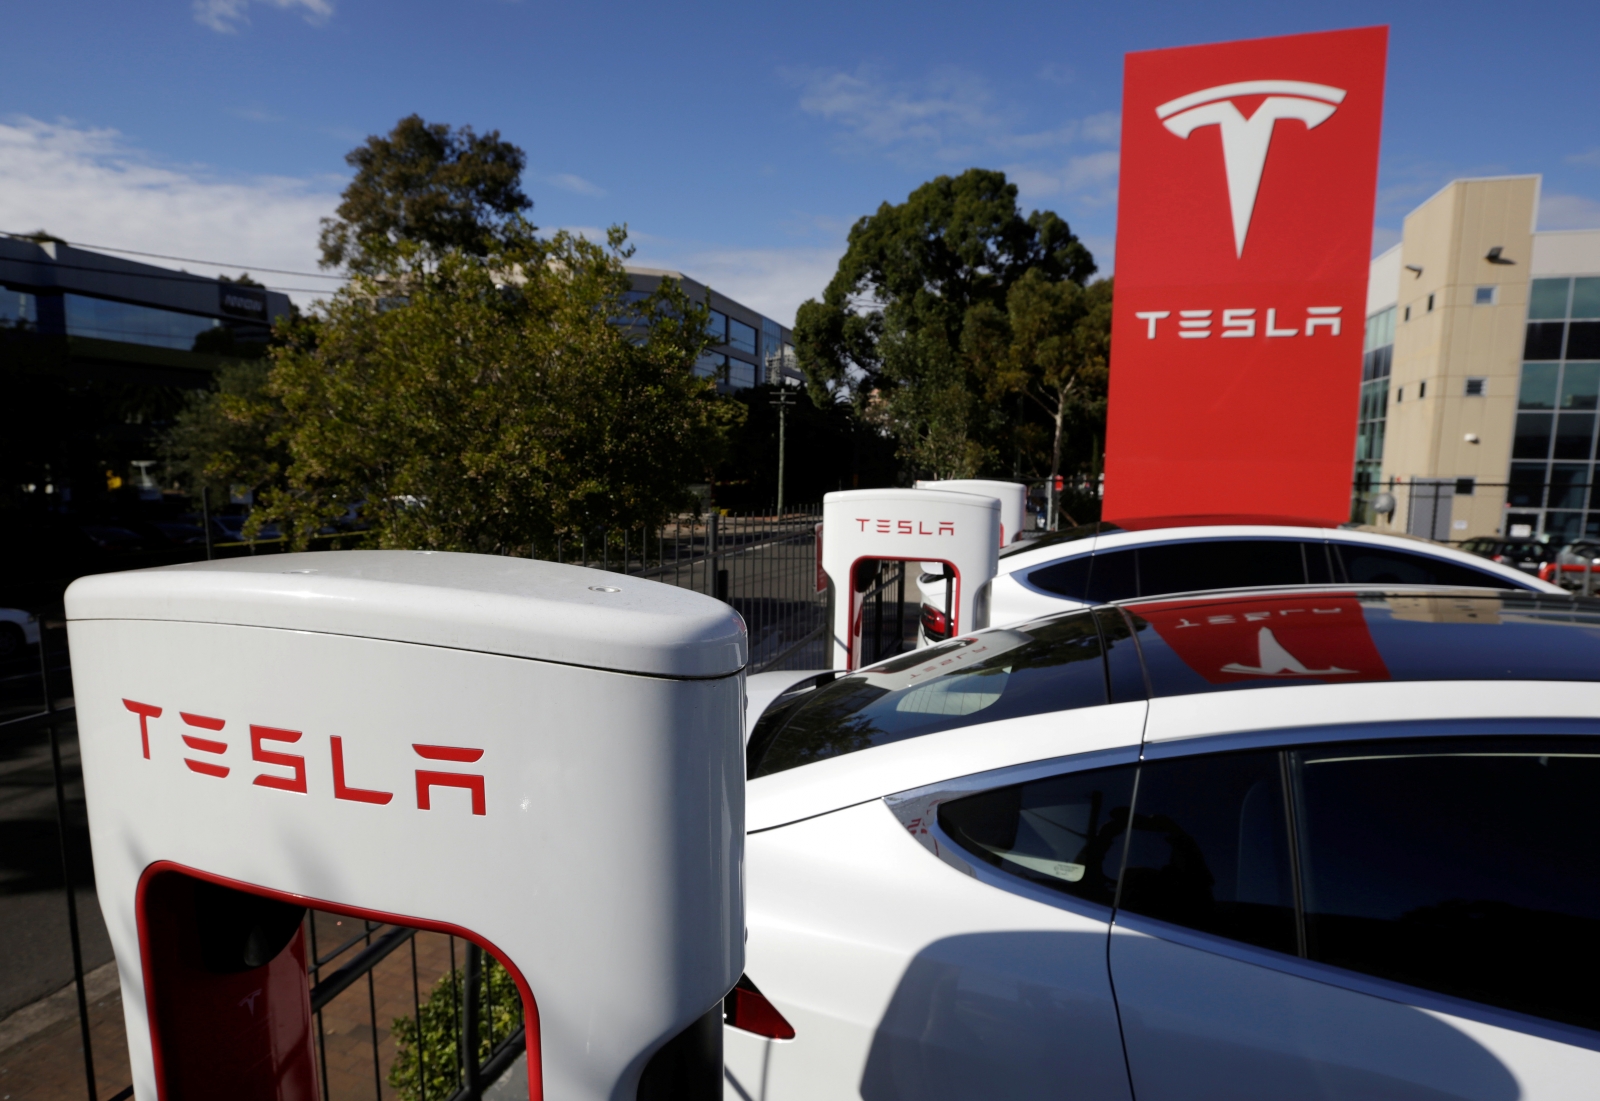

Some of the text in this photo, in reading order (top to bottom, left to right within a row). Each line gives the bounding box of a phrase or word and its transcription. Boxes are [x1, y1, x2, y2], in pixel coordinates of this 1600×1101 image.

[1135, 306, 1343, 340] TESLA
[856, 518, 955, 536] TESLA
[122, 698, 487, 816] TESLA
